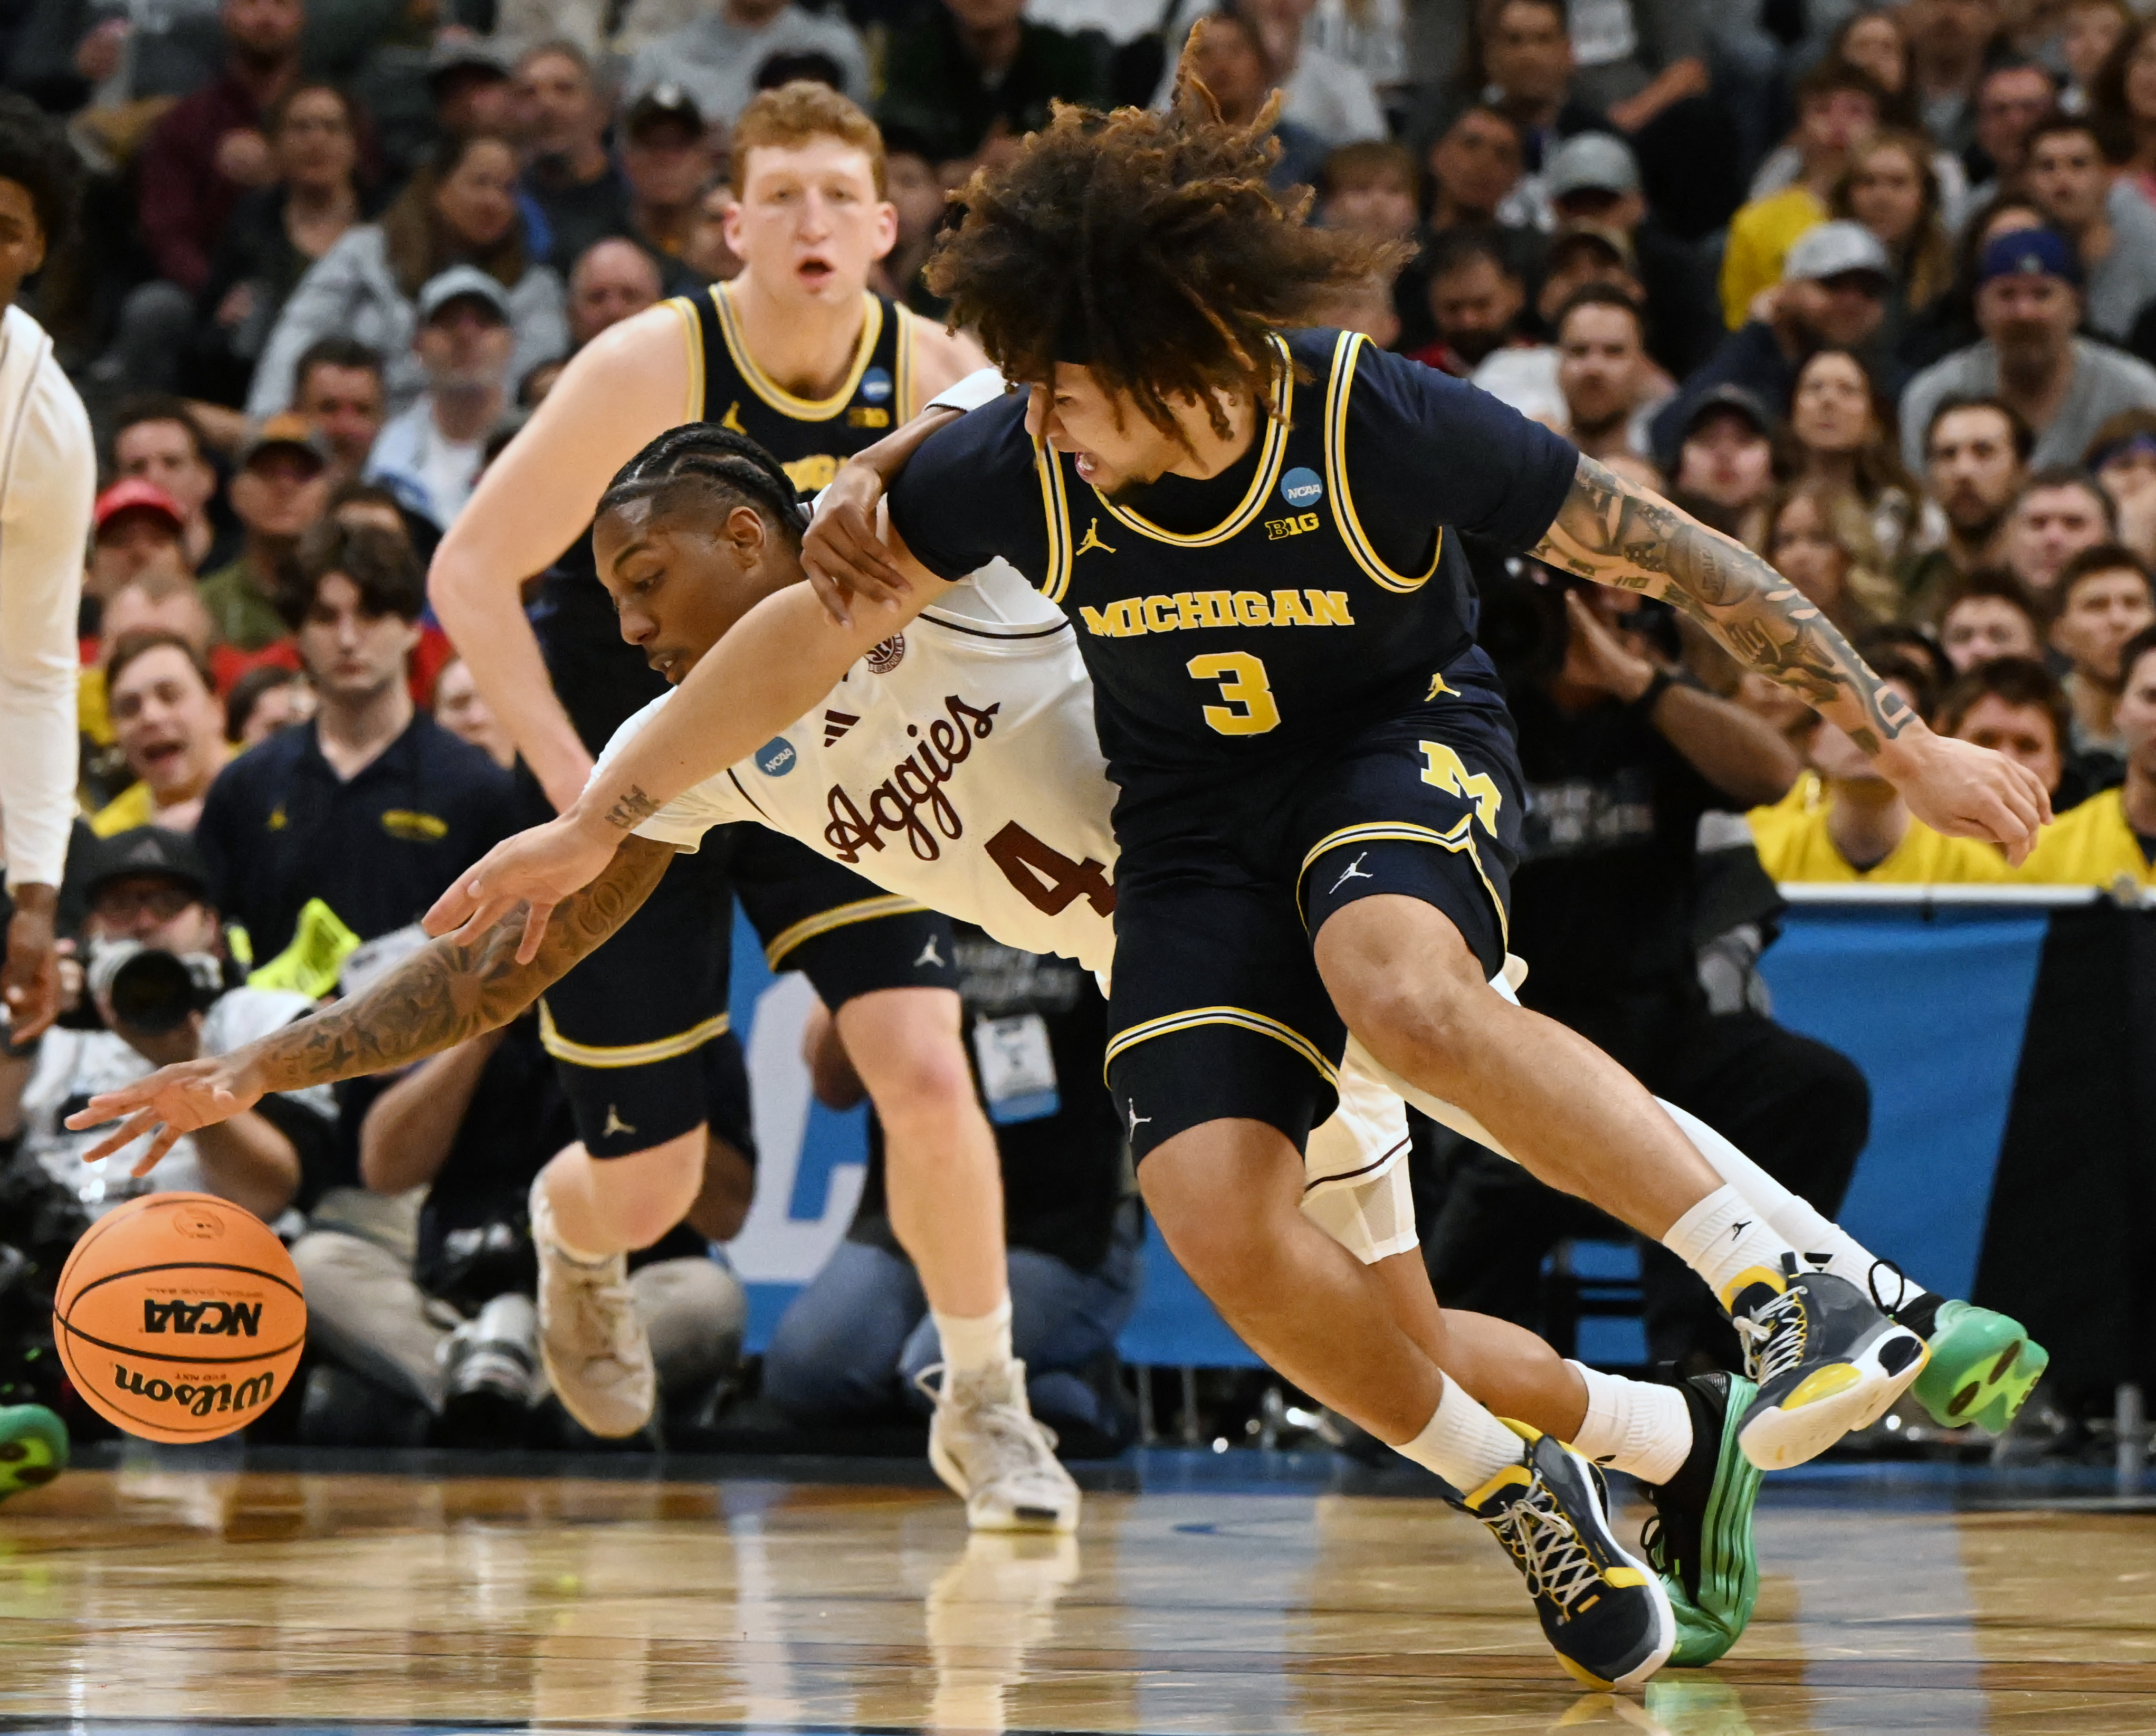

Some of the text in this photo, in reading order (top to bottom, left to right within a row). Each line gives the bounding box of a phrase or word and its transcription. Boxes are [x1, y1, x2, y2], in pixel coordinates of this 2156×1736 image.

[1287, 483, 1322, 499] NCAA
[1080, 588, 1354, 638] MICHIGAN
[1186, 651, 1281, 736] 3
[765, 747, 794, 772] NCAA
[824, 694, 1000, 864] Aggies
[1418, 740, 1502, 838] M
[984, 819, 1116, 918] 4
[144, 1298, 263, 1337] NCAA
[115, 1364, 275, 1417] Wilson
